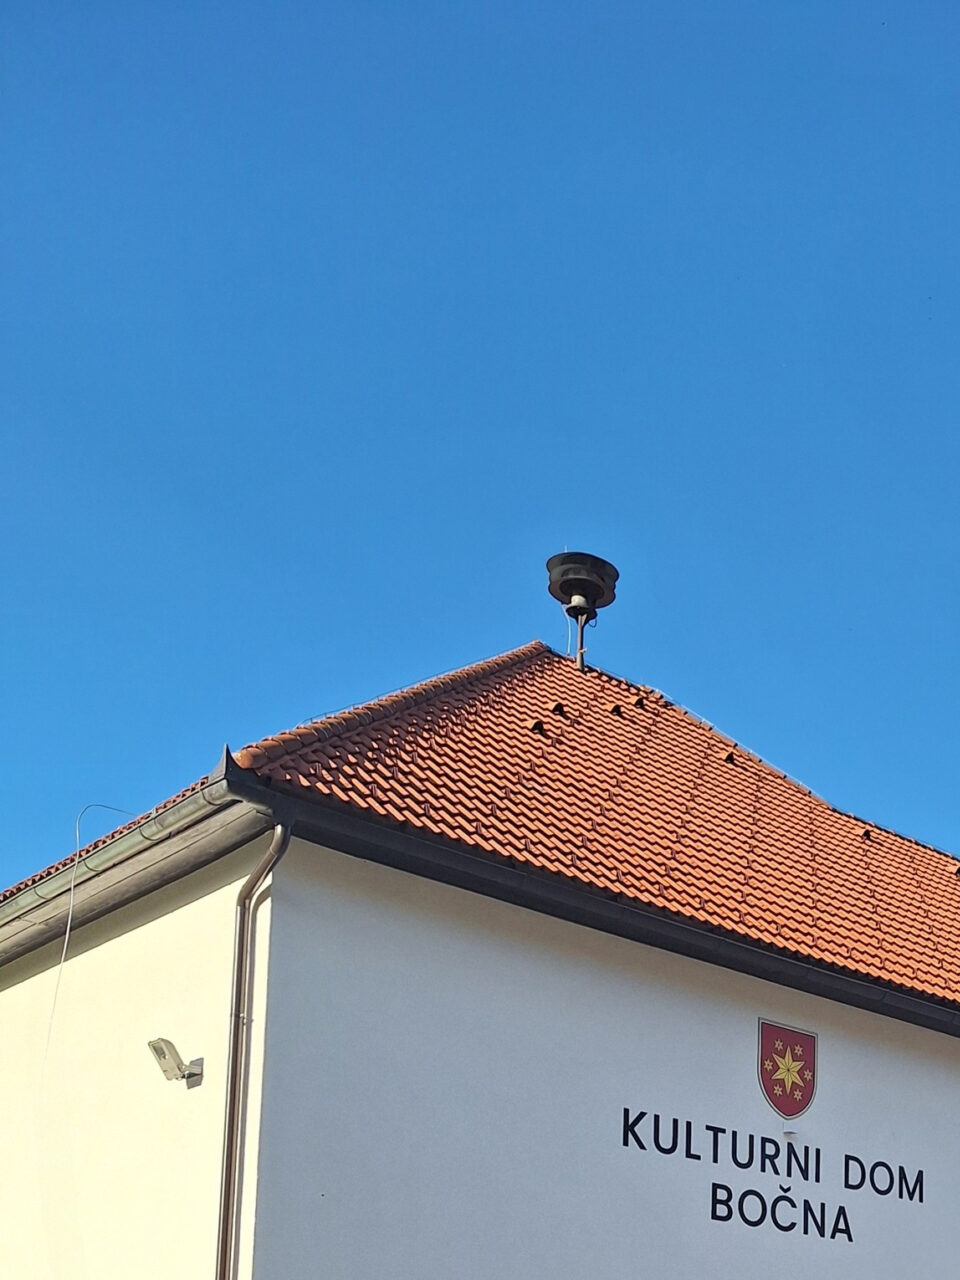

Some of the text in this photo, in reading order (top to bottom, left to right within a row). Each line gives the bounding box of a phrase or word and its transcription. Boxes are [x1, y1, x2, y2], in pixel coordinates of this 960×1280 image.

[621, 1107, 924, 1204] KULTURNI DOM
[710, 1182, 854, 1243] BOČNA
